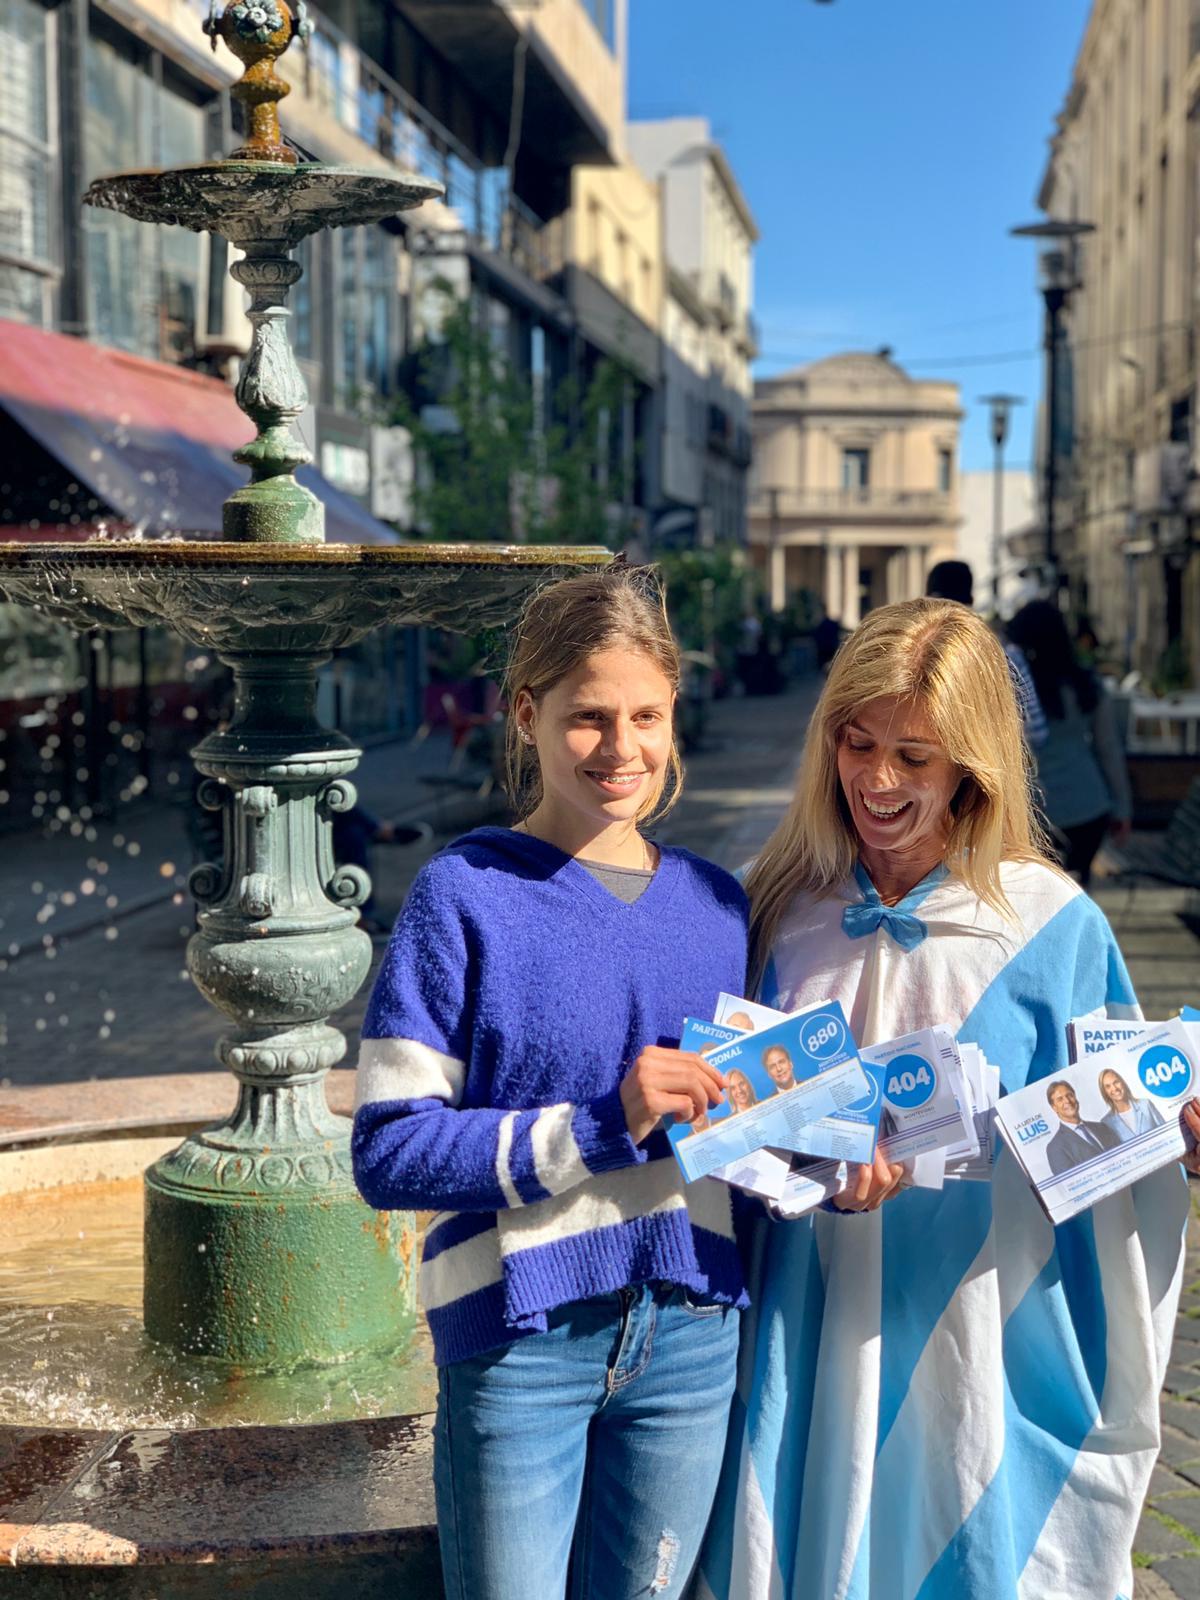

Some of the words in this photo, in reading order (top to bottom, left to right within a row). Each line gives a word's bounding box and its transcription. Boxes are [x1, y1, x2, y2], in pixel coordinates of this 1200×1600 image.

[691, 1022, 734, 1041] PARTIDO
[807, 1021, 838, 1052] 880
[888, 1066, 931, 1096] 404
[1145, 1055, 1187, 1087] 404
[1017, 1119, 1049, 1141] LUIS
